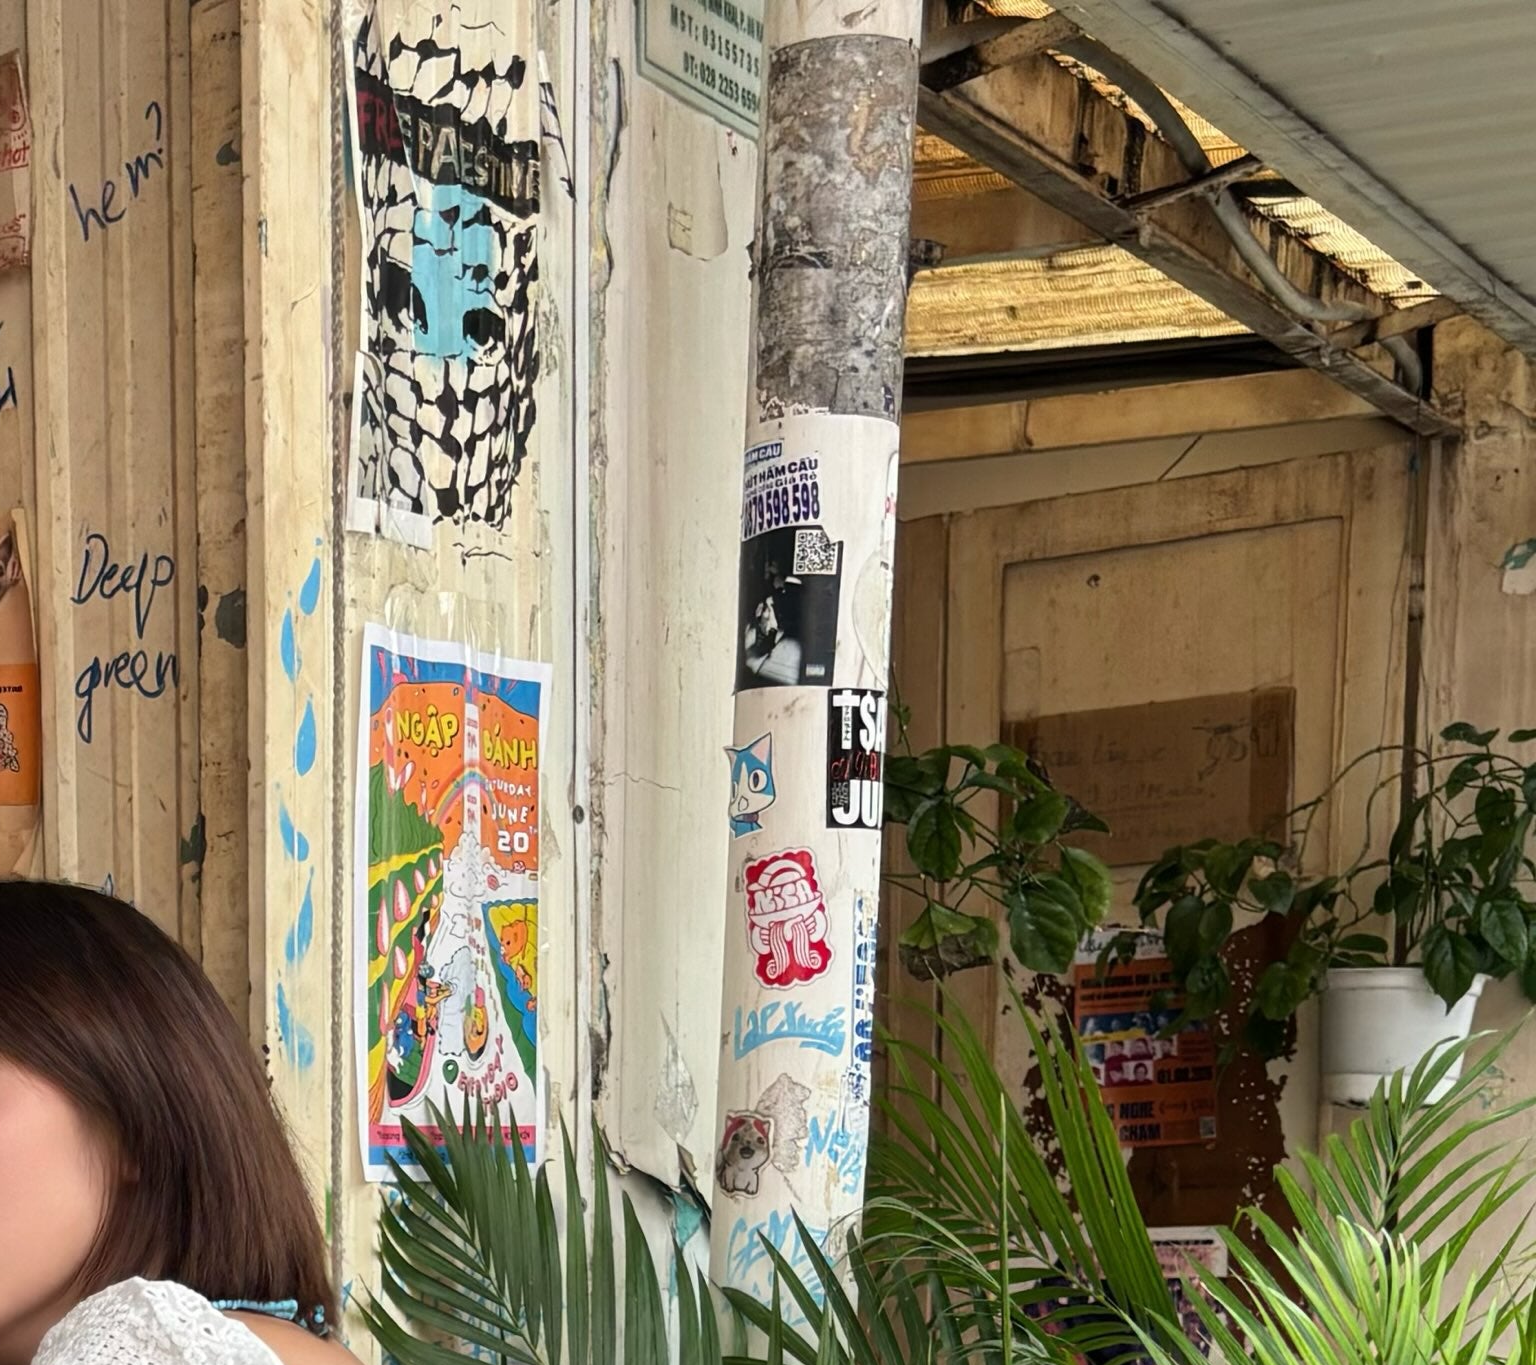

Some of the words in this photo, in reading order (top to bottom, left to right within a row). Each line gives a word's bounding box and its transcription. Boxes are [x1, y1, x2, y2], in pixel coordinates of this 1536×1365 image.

[418, 117, 541, 200] PAESTINE
[70, 533, 175, 639] Deep
[75, 650, 179, 743] green
[396, 704, 459, 757] NGẬP
[482, 723, 538, 771] BÁNH
[492, 802, 529, 825] JUNE
[498, 830, 529, 853] 20
